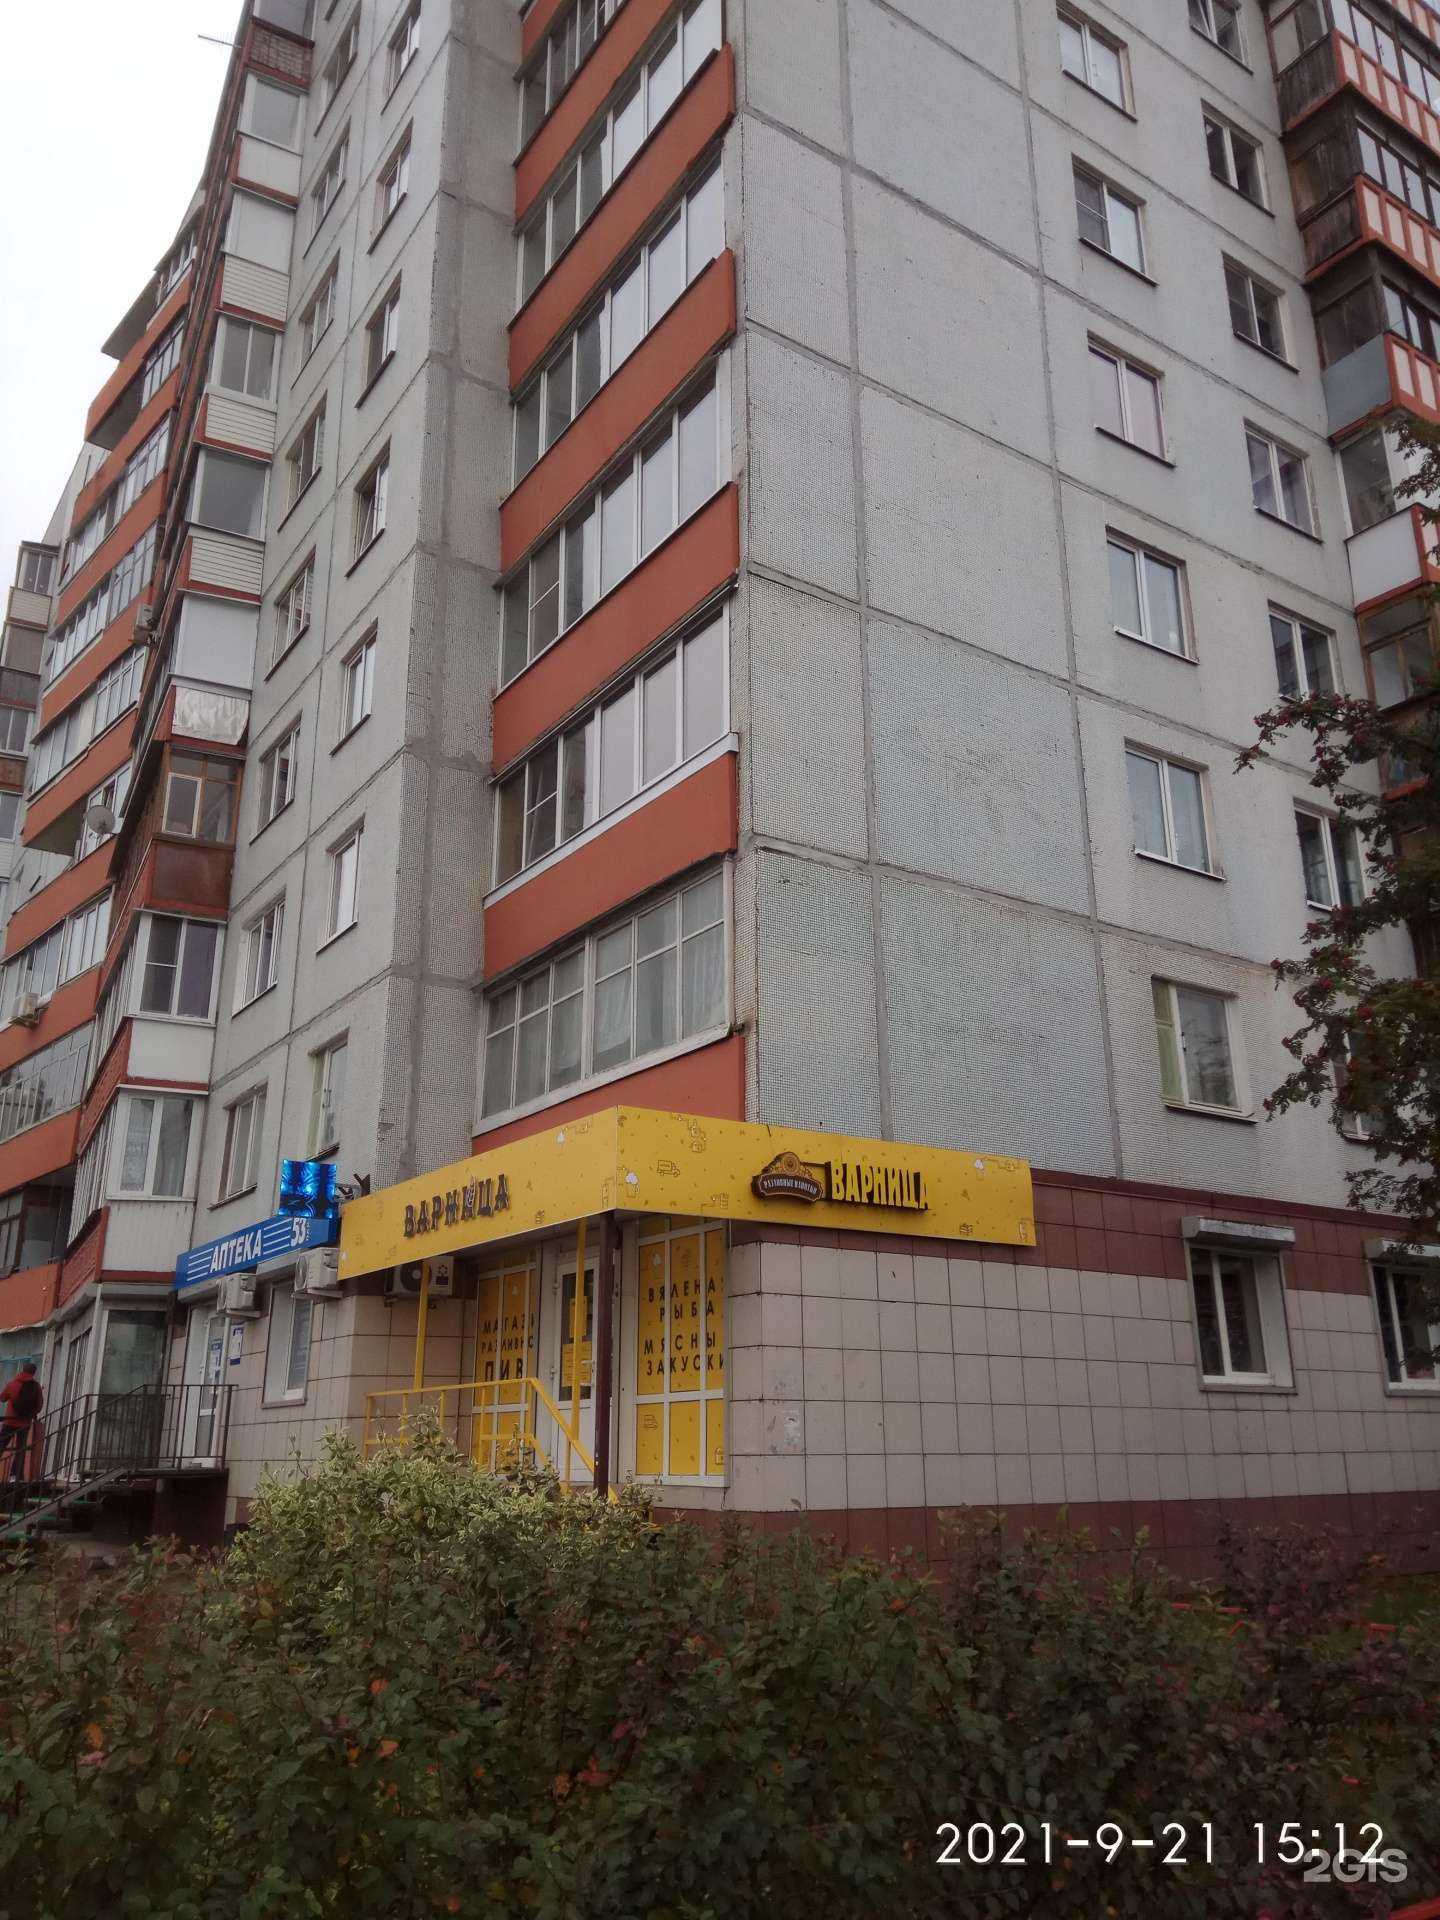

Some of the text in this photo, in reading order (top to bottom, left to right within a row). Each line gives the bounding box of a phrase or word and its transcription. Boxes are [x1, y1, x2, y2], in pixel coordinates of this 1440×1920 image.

[831, 1159, 929, 1210] ВАРНИЦА
[403, 1173, 510, 1237] ВАРНИЦА
[209, 1229, 262, 1273] АПТЕКА
[290, 1217, 307, 1247] 53
[648, 1276, 724, 1303] ВЯЛЕНА
[660, 1300, 715, 1322] РЫБА
[644, 1331, 716, 1355] МЯСНЫ
[484, 1358, 524, 1382] ПИВ
